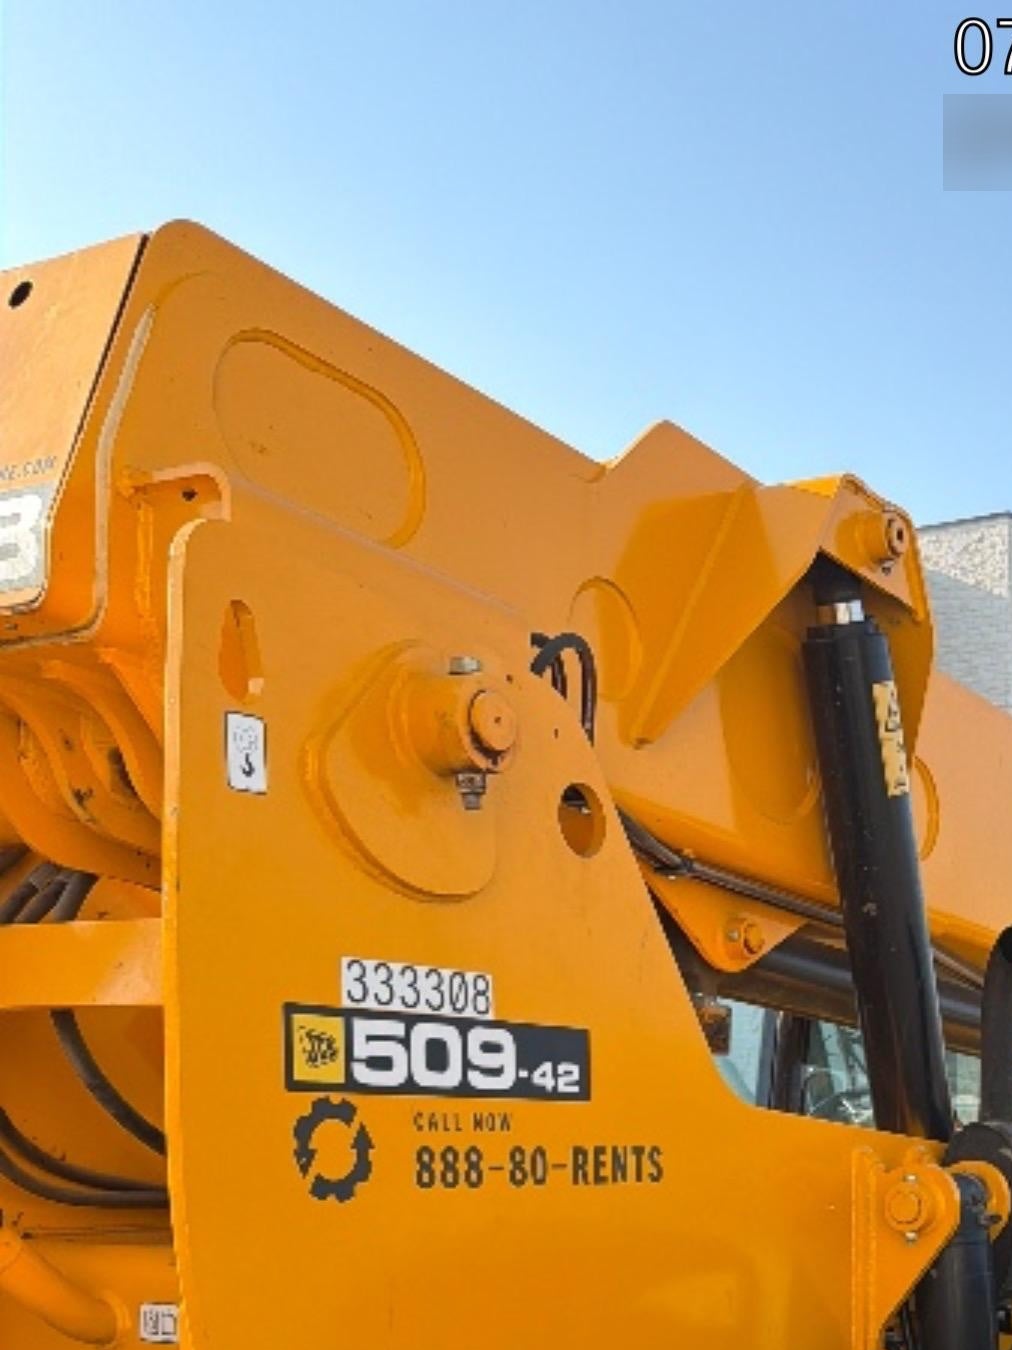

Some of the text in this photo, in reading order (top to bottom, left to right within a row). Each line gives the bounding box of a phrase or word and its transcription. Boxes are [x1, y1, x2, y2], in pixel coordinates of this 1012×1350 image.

[346, 959, 490, 1015] 333308
[350, 1016, 581, 1094] 509-42
[413, 1111, 513, 1133] CALL NOW
[415, 1145, 664, 1189] 888-80-RENTS
